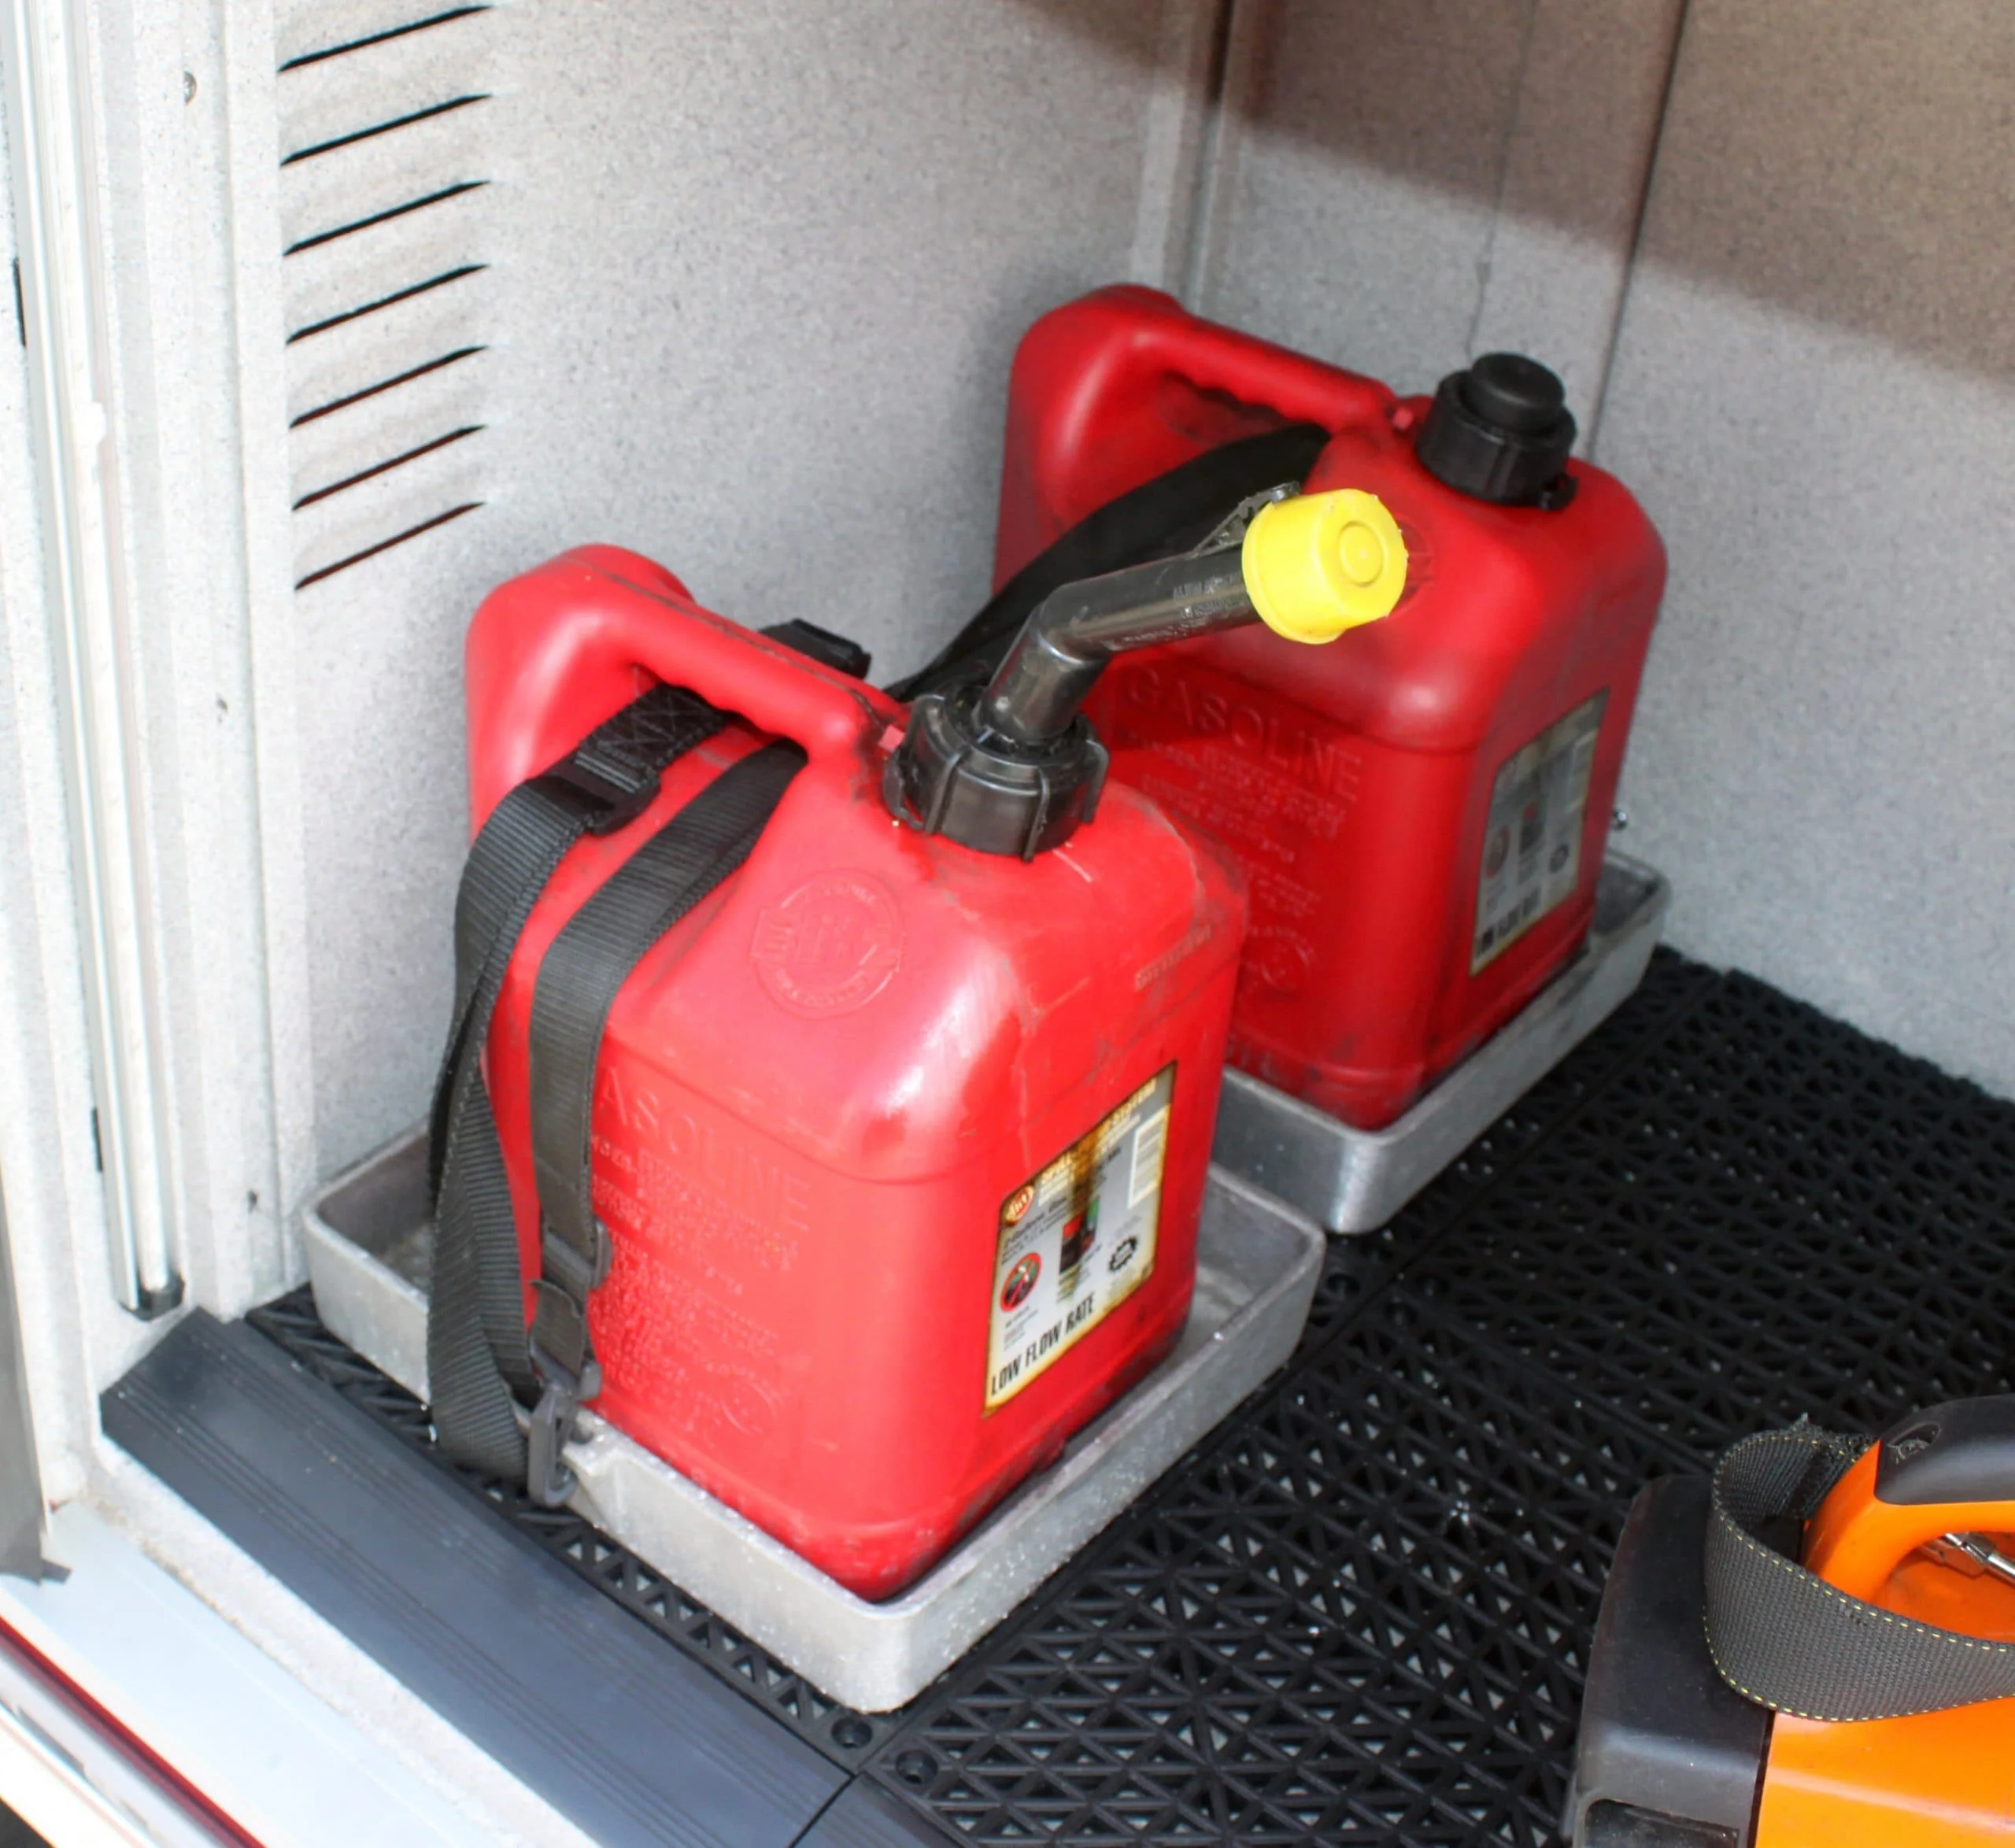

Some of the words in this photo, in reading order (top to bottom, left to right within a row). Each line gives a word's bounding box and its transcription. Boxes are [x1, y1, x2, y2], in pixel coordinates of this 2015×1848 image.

[1128, 663, 1362, 804] GASOLINE
[600, 1066, 811, 1233] ASOLINE
[991, 1354, 1022, 1395] LOW
[1026, 1321, 1062, 1367] FLOW
[1066, 1291, 1095, 1332] RATE
